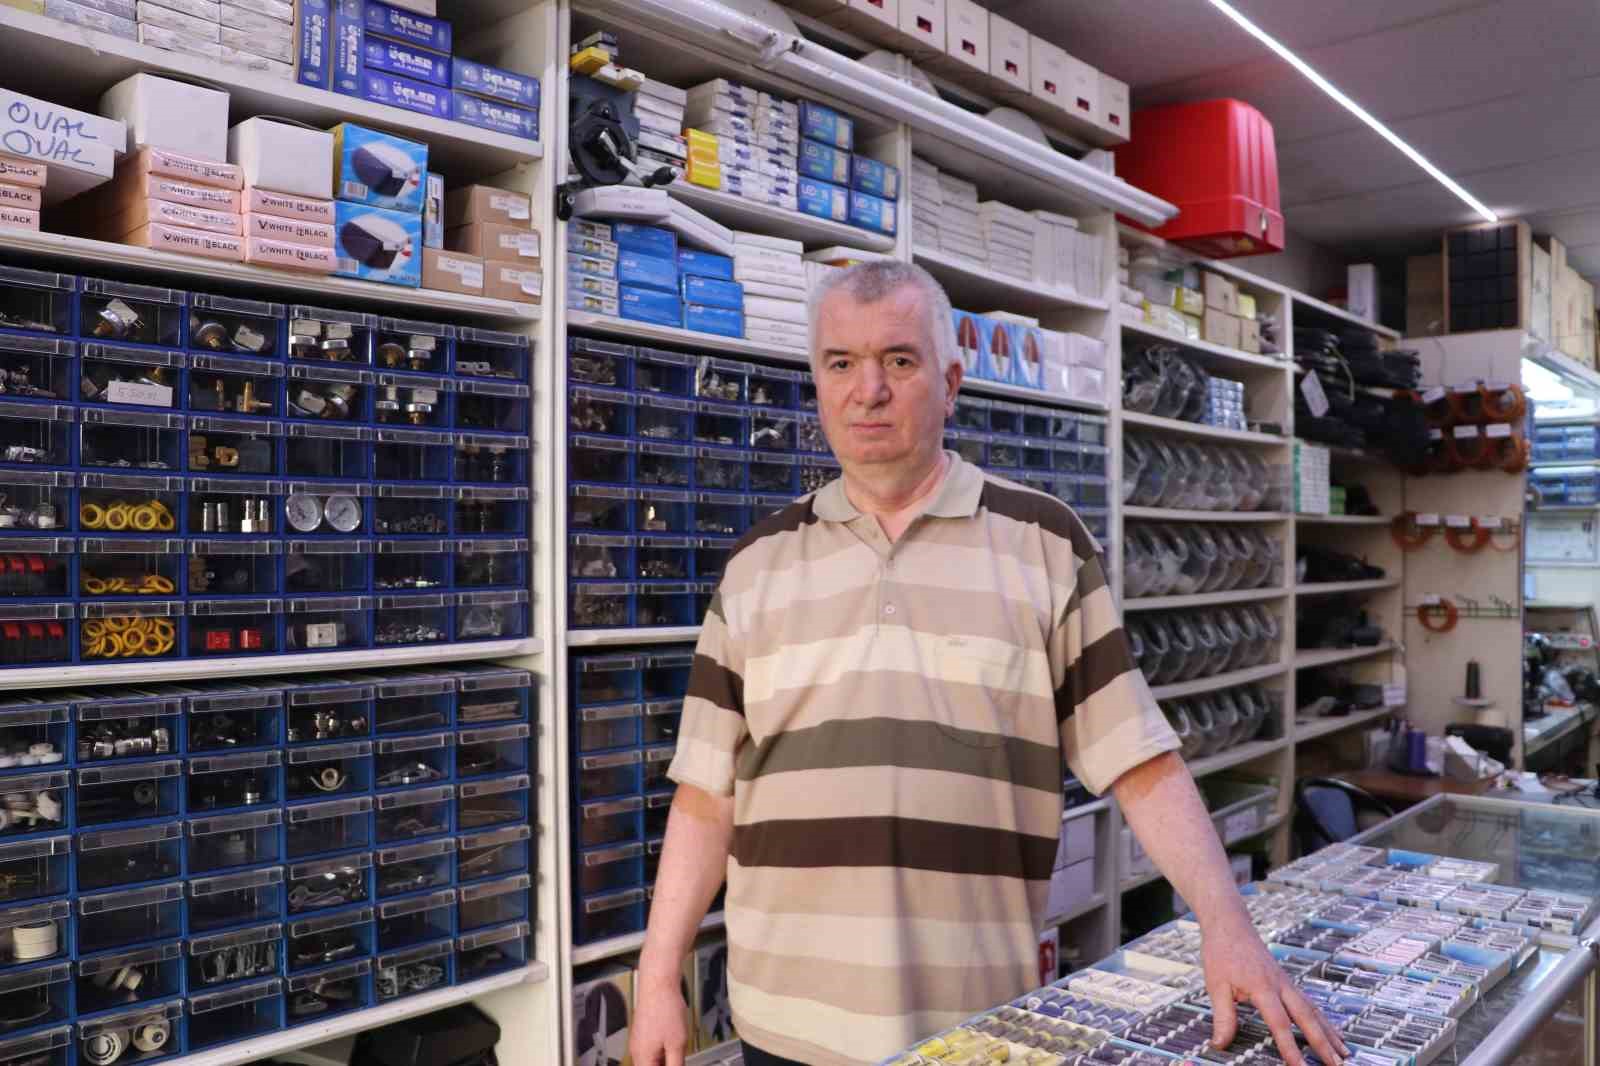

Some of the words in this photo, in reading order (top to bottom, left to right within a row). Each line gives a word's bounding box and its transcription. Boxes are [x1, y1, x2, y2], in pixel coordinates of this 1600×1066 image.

[7, 101, 98, 139] OVAL
[2, 129, 96, 167] OVAL
[2, 189, 33, 202] BLACK
[270, 199, 294, 209] WHITE
[304, 204, 329, 215] BLACK
[1, 211, 32, 225] BLACK
[269, 222, 293, 233] WHITE
[304, 226, 329, 238] BLACK
[172, 235, 200, 247] WHITE
[211, 241, 240, 252] BLACK
[268, 246, 293, 256] WHITE
[304, 251, 329, 261] BLACK
